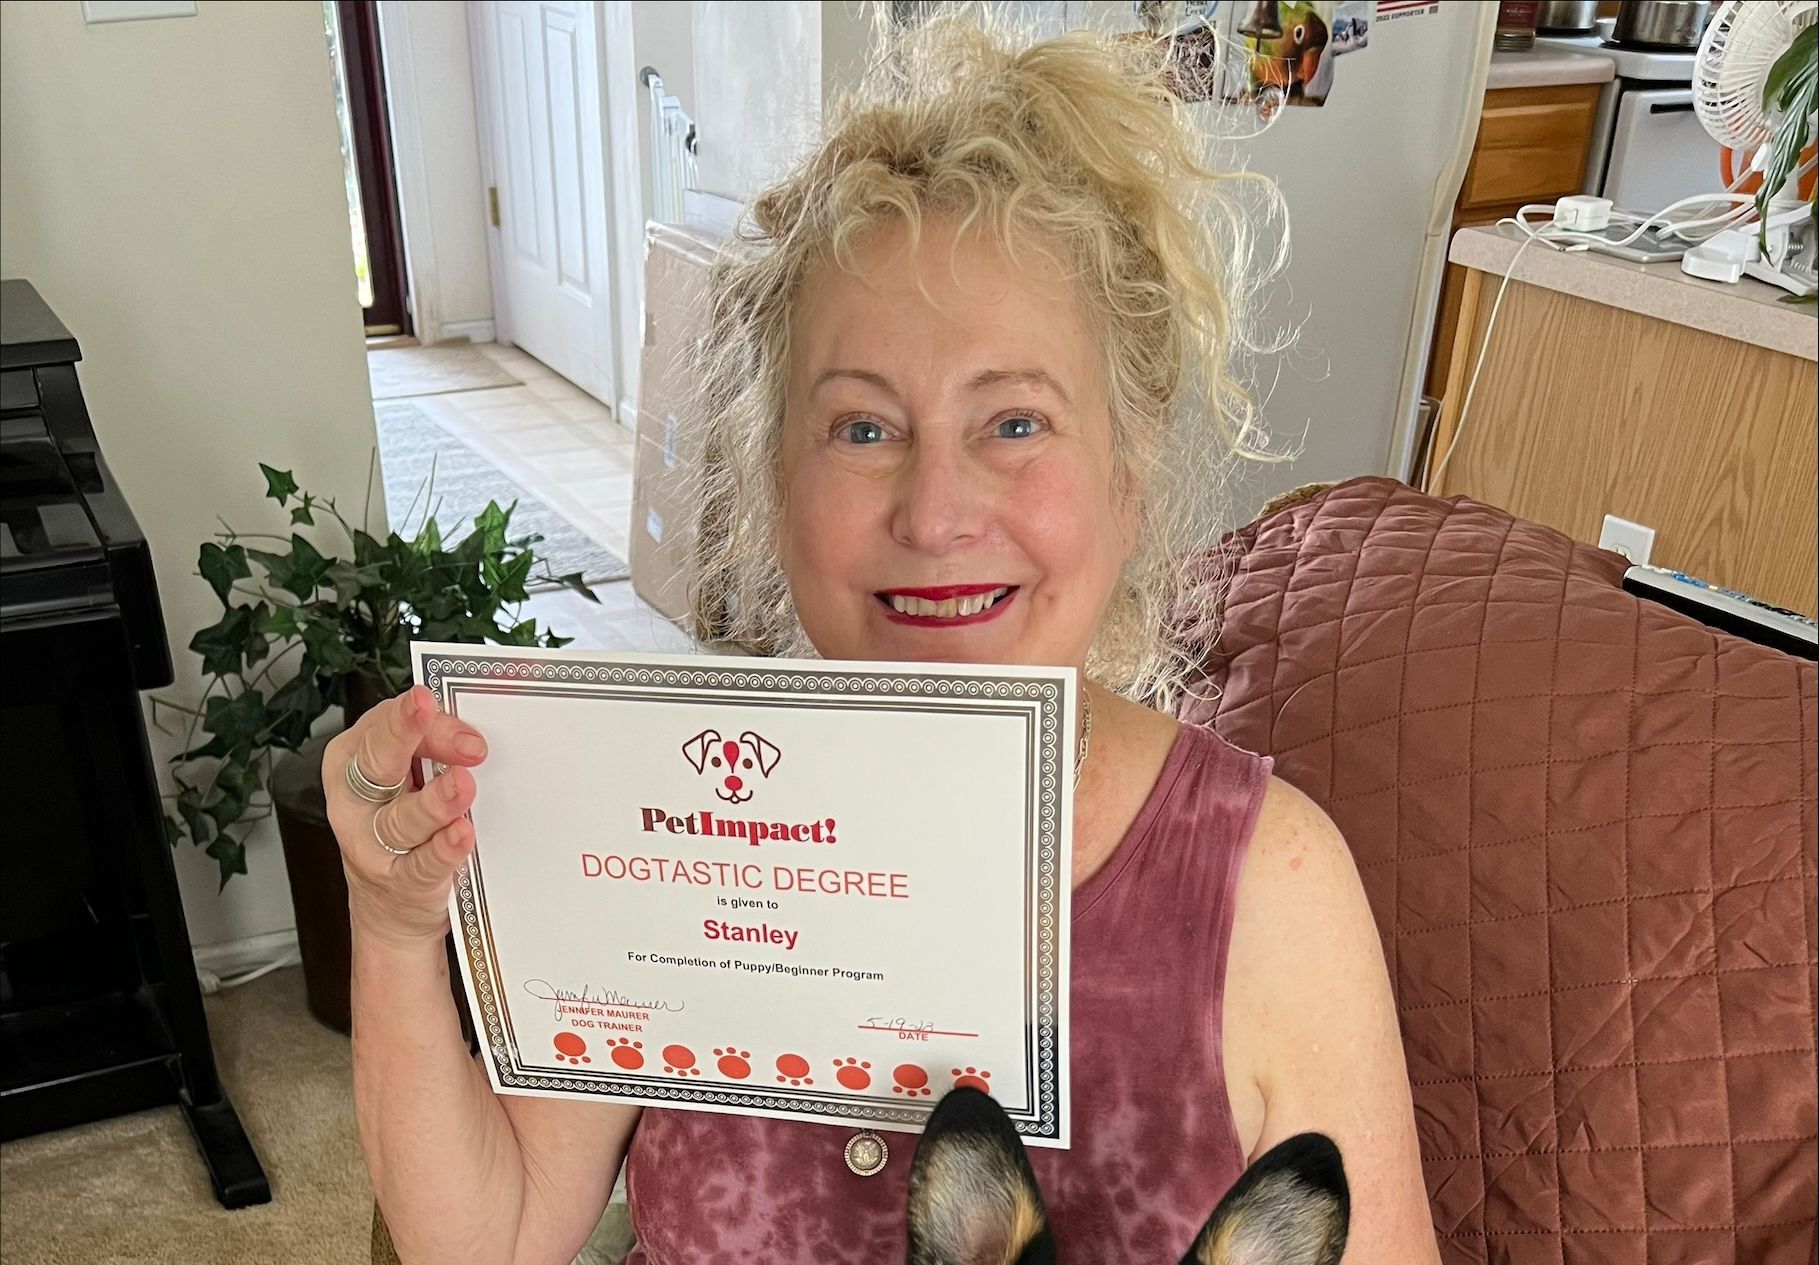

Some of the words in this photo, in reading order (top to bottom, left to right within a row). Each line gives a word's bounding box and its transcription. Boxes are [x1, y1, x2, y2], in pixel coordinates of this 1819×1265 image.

[639, 807, 837, 847] PetImpact!
[581, 853, 763, 889] DOGTASTIC
[773, 866, 909, 899] DEGREE
[717, 895, 728, 906] is
[730, 897, 764, 911] given
[766, 899, 779, 910] to
[703, 919, 799, 950] Stanley
[627, 951, 647, 962] For
[650, 953, 717, 968] Completion
[719, 960, 731, 970] of
[734, 960, 830, 977] Puppy/Beginner
[832, 967, 884, 982] Program
[557, 1004, 605, 1017] JENNIFER
[606, 1009, 650, 1021] MAURER
[571, 1018, 595, 1029] DOG
[598, 1021, 643, 1033] TRAINER
[898, 1031, 929, 1042] DATE
